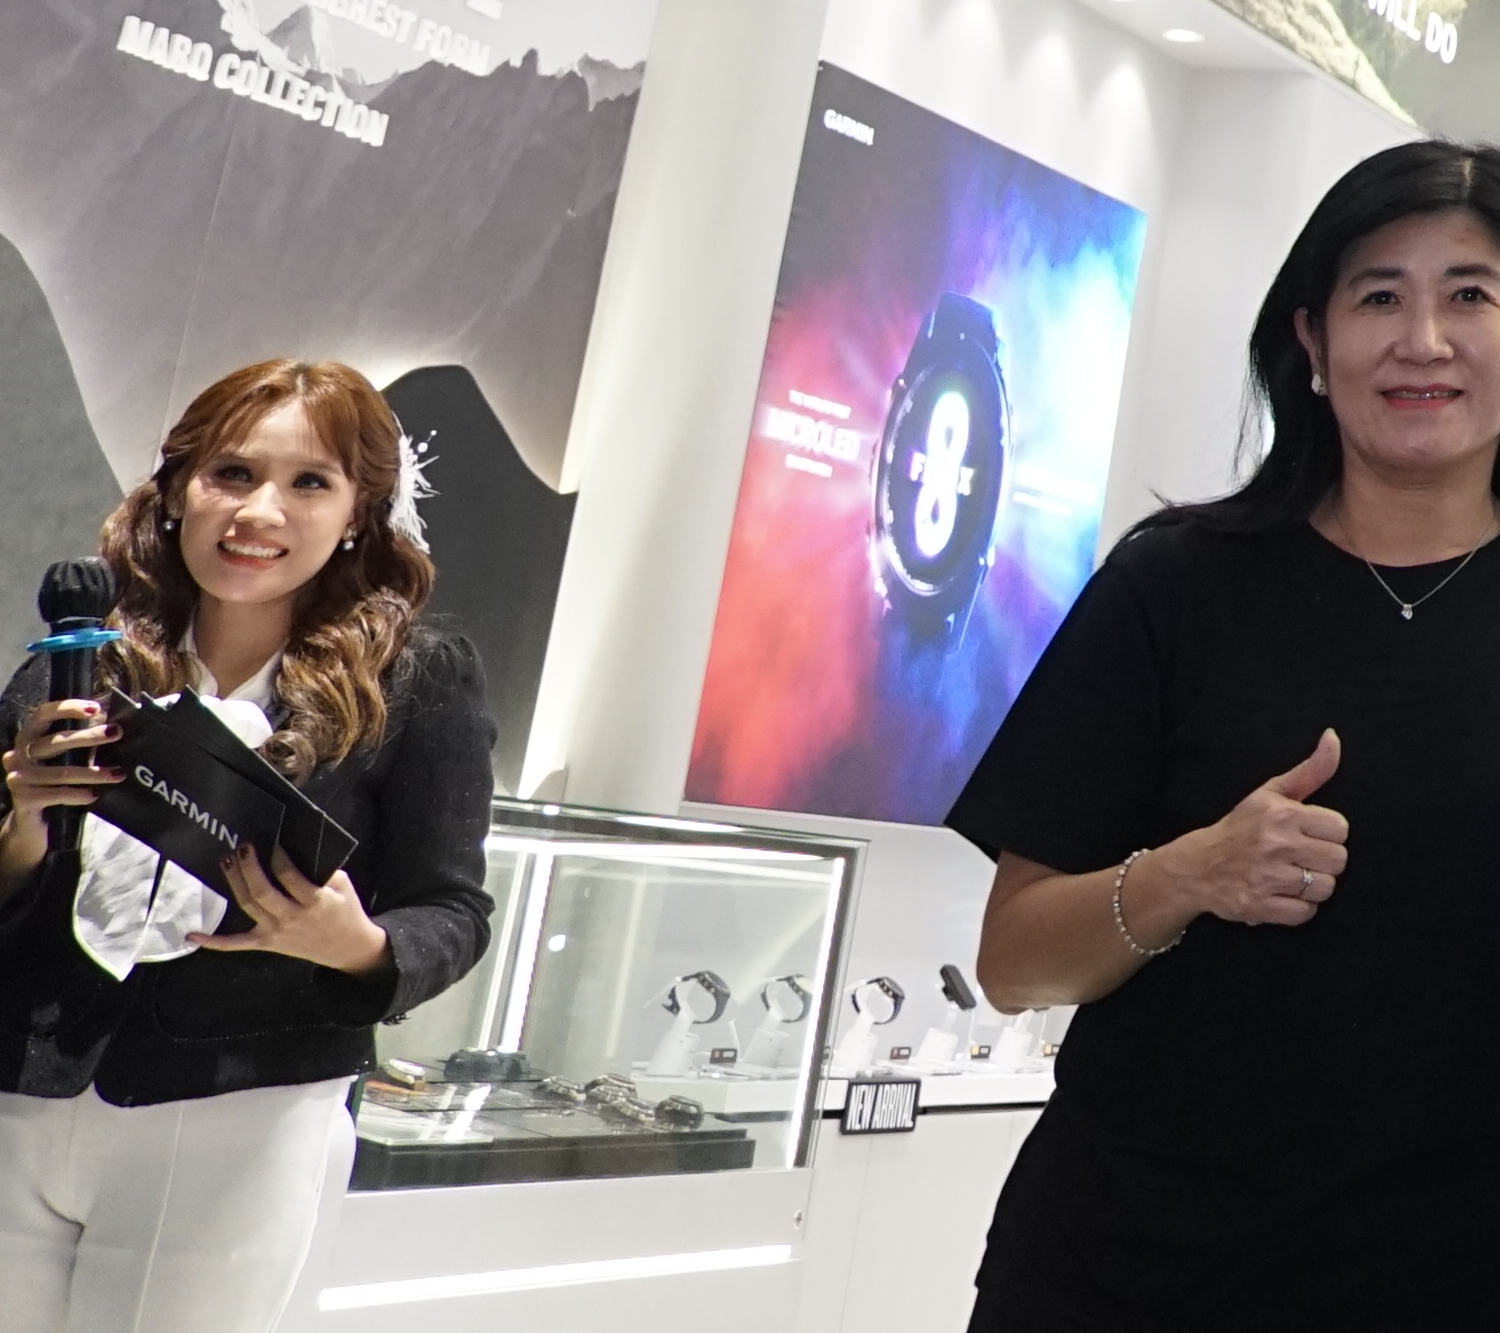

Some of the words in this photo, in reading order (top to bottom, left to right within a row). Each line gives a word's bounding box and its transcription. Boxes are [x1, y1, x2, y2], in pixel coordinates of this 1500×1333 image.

[412, 17, 491, 77] FORM
[1424, 11, 1459, 64] DO
[116, 14, 214, 82] MARQ
[213, 52, 390, 148] COLLECTION
[823, 107, 875, 147] GARMIN
[134, 765, 239, 850] GARMIN
[847, 1085, 876, 1130] NEW
[873, 1083, 916, 1128] ARRIVAL
